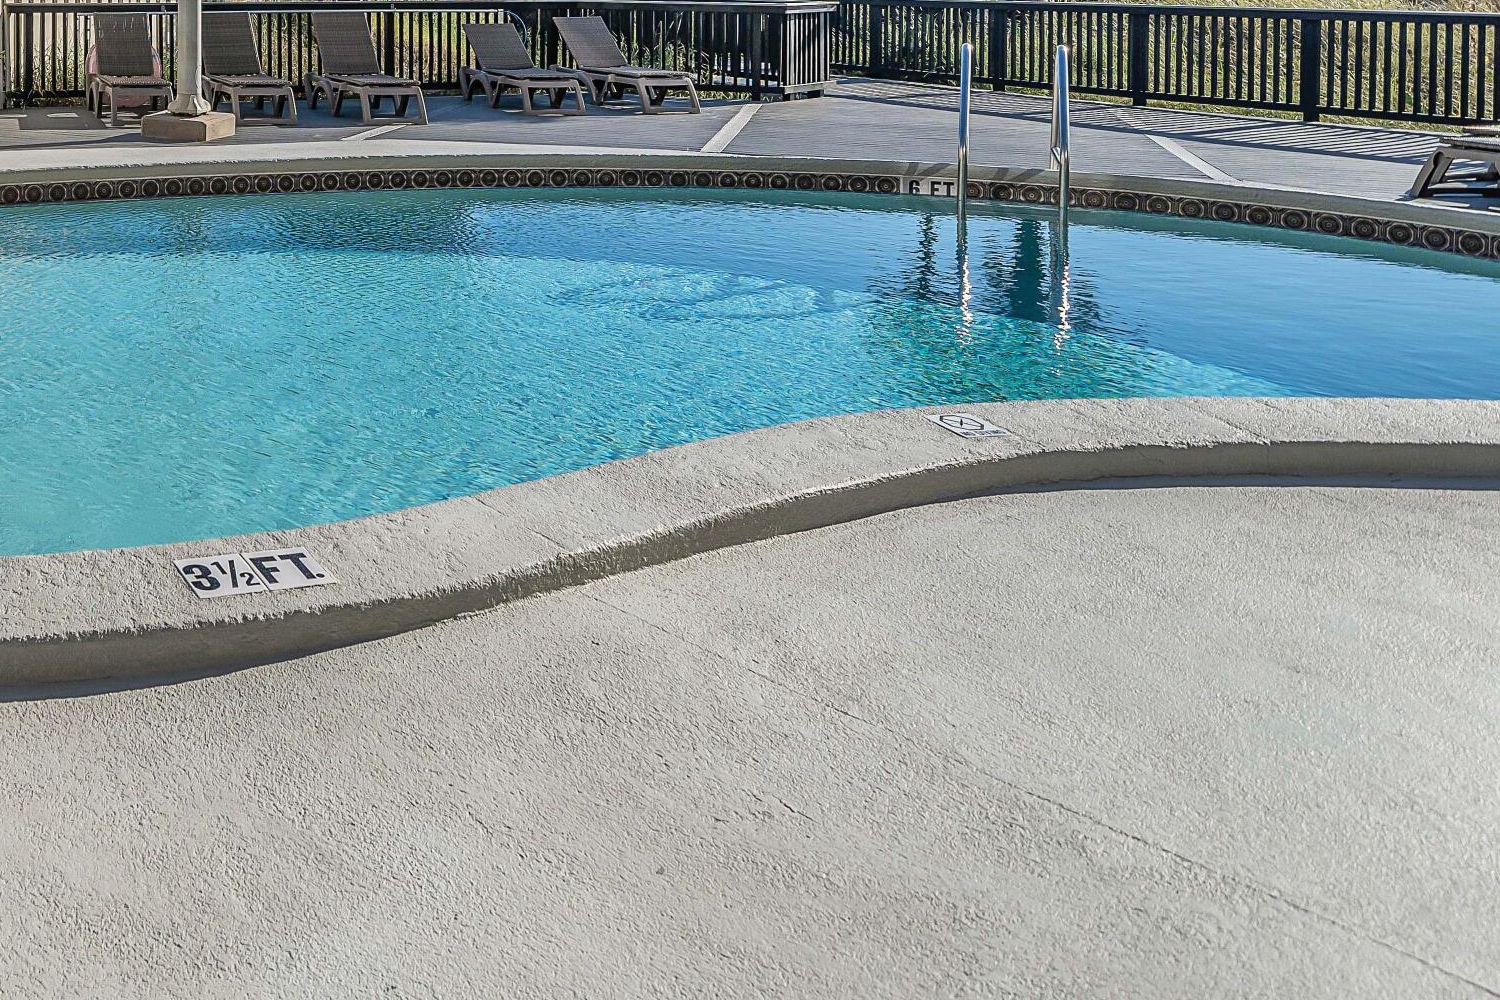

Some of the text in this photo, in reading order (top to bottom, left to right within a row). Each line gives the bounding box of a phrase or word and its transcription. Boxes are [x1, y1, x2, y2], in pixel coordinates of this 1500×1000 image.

[908, 179, 955, 197] 6 FT
[250, 552, 325, 585] FT.
